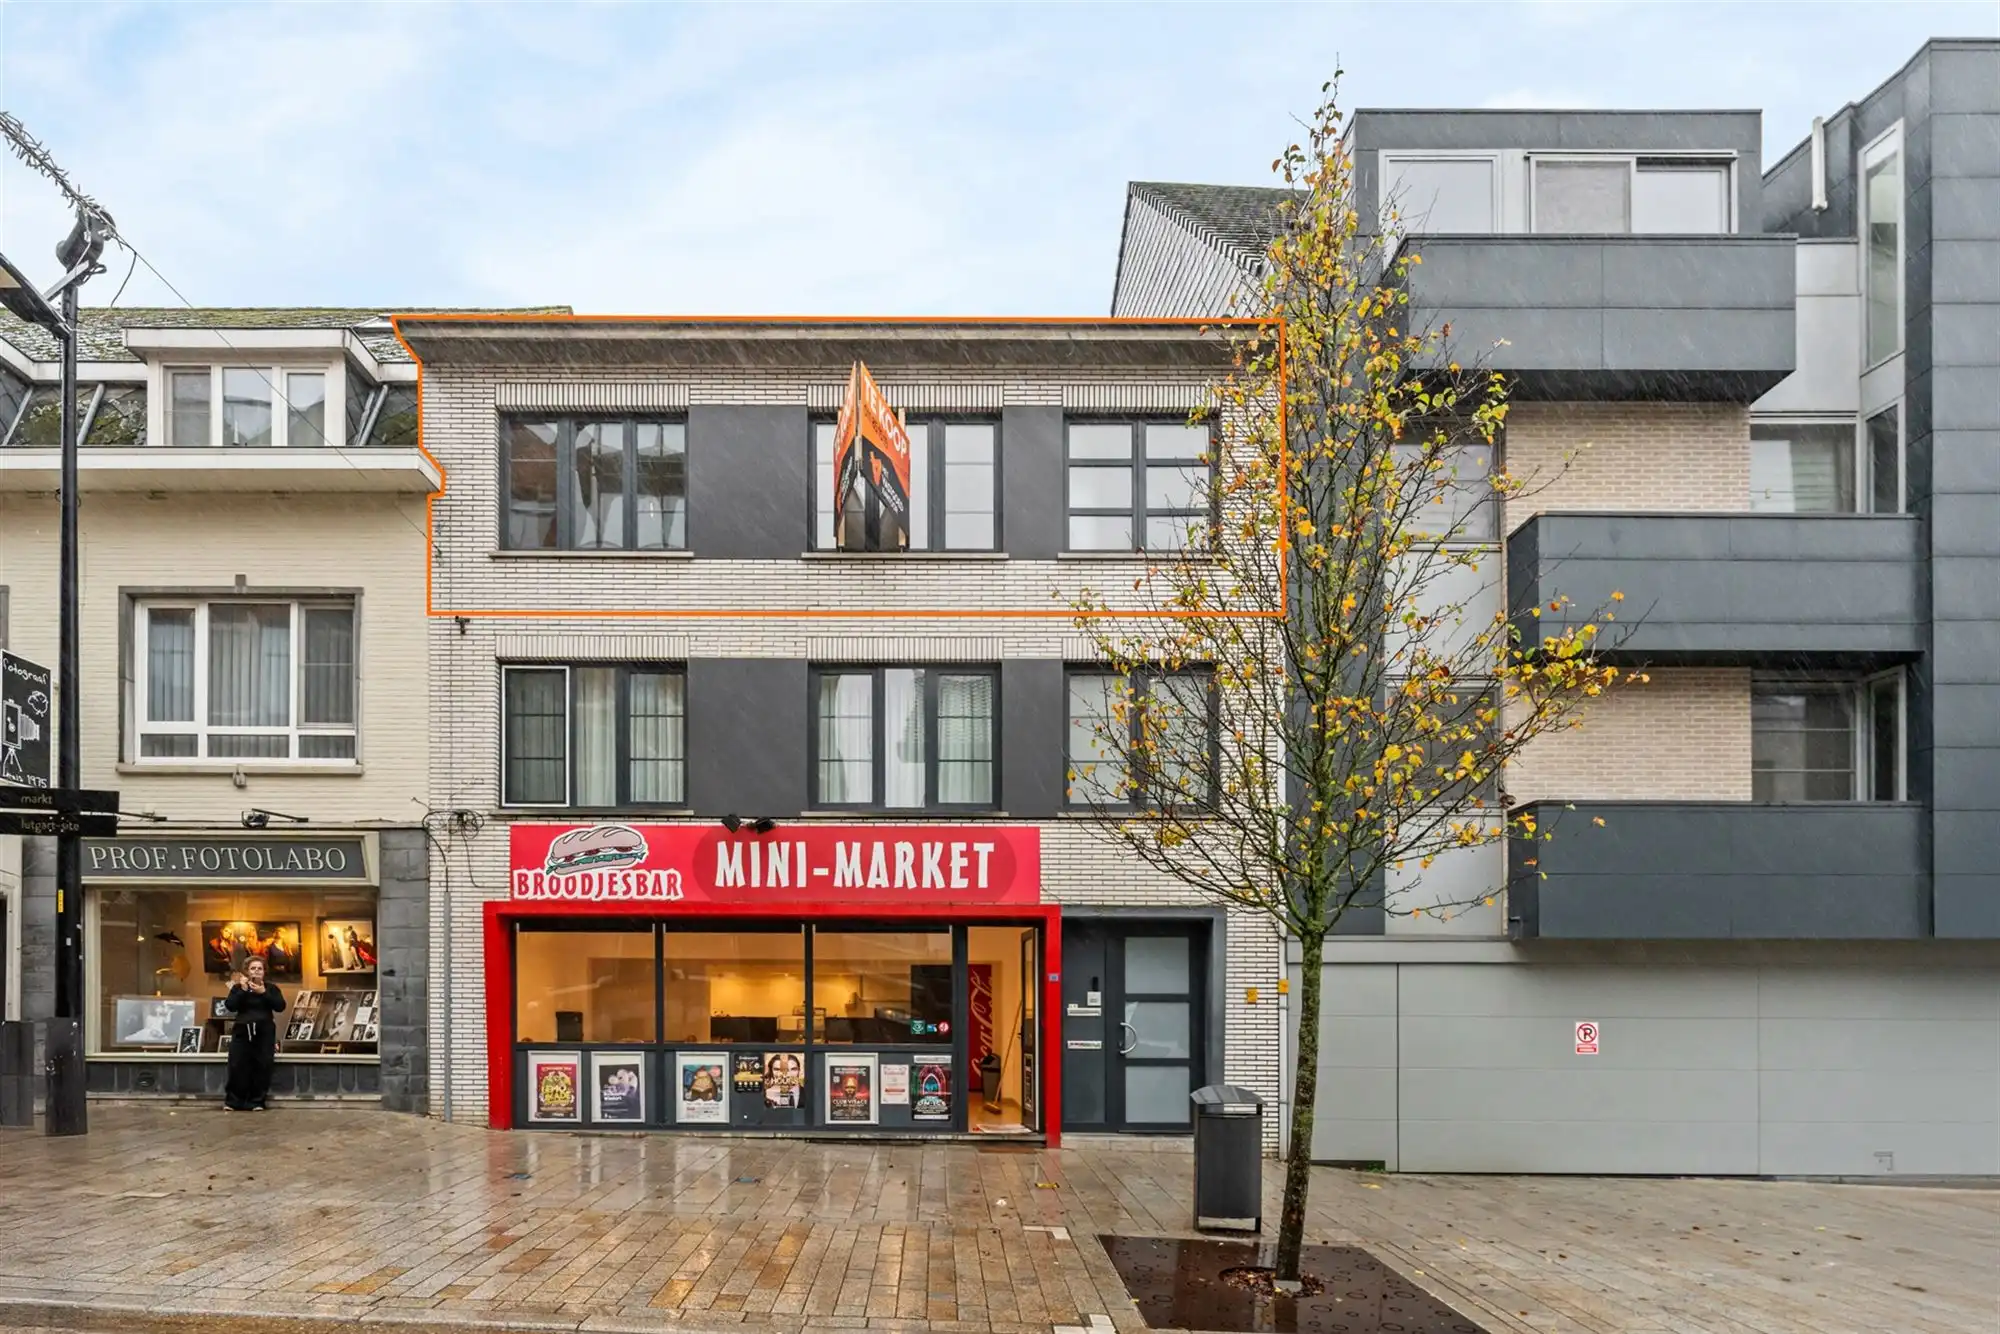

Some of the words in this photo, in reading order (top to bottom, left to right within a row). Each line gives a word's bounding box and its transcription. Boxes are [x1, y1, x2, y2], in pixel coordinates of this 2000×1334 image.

[2, 656, 49, 685] fotograaf
[26, 774, 48, 789] 1975
[20, 792, 53, 805] markt
[714, 840, 995, 890] MINI-MARKET
[514, 870, 683, 899] BROODJESBAR
